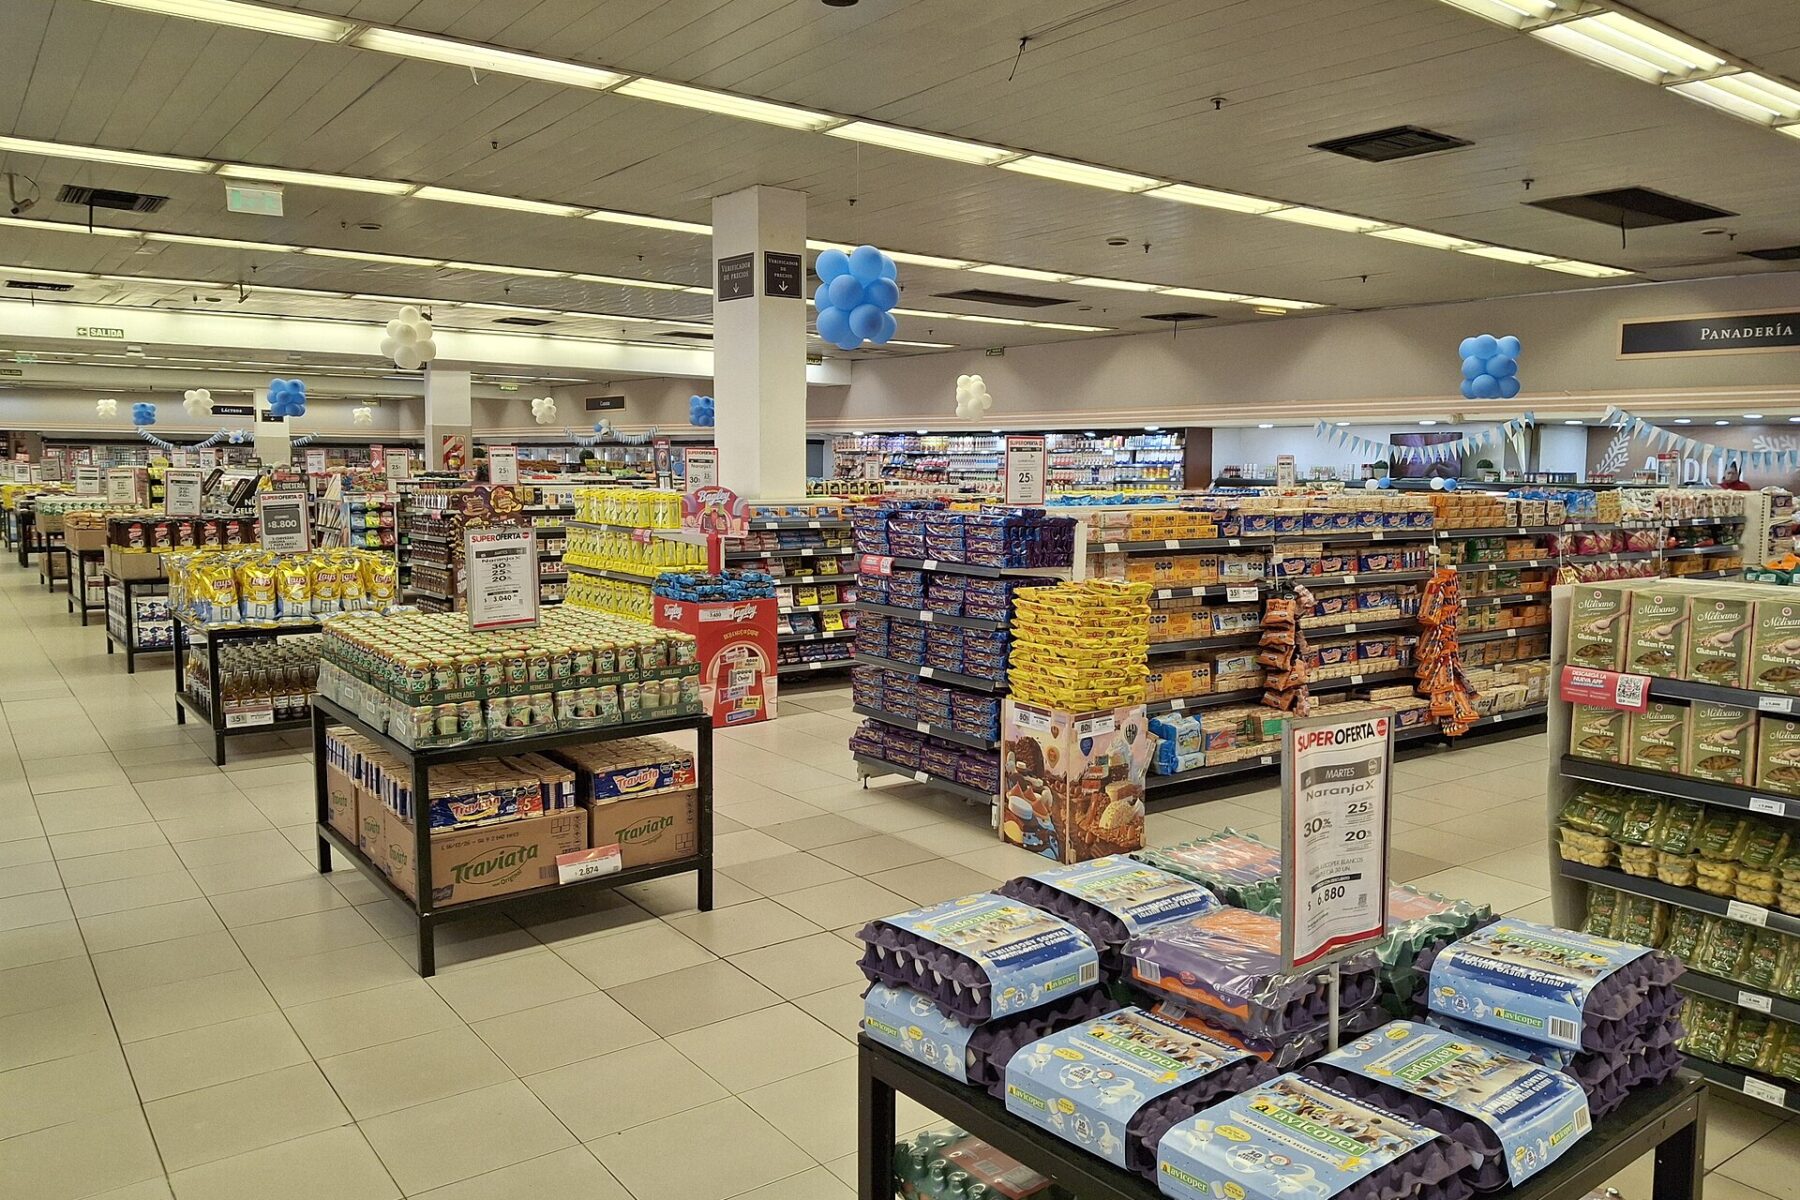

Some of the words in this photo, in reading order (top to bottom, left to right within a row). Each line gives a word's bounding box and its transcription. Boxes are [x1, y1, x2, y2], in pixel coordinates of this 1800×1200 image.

[90, 328, 124, 338] SALIDA
[1700, 322, 1793, 340] PANADERÍA
[698, 488, 730, 504] Bagley
[472, 532, 520, 543] SUPEROFERTA
[1578, 633, 1597, 641] Gluten
[1638, 640, 1658, 648] Gluten
[1696, 648, 1719, 657] Gluten
[1720, 650, 1736, 658] Free
[1762, 654, 1785, 663] Gluten
[444, 691, 476, 700] MERMELADAS
[1298, 723, 1375, 752] SUPEROFERTA
[1582, 726, 1599, 735] Gluten
[1601, 728, 1614, 736] Free
[1641, 736, 1660, 744] Gluten
[1661, 739, 1674, 747] Free
[1700, 744, 1723, 753] Gluten
[1724, 746, 1740, 755] Free
[1769, 756, 1792, 766] Gluten
[618, 768, 658, 789] Traviata
[1326, 768, 1355, 779] MARTES
[452, 796, 500, 816] Traviata
[615, 815, 674, 843] Traviata
[450, 844, 538, 884] Traviata
[579, 866, 599, 876] 2.874
[1307, 902, 1311, 911] $
[1317, 886, 1345, 906] 6.880
[1504, 1012, 1542, 1028] avicoper
[1108, 1034, 1181, 1071] avicoper
[1402, 1049, 1450, 1080] avicoper
[1015, 1089, 1044, 1110] avicoper
[1350, 1096, 1422, 1128] ARGENTINA!
[1278, 1108, 1364, 1154] avicoper
[1169, 1166, 1208, 1192] avicoper
